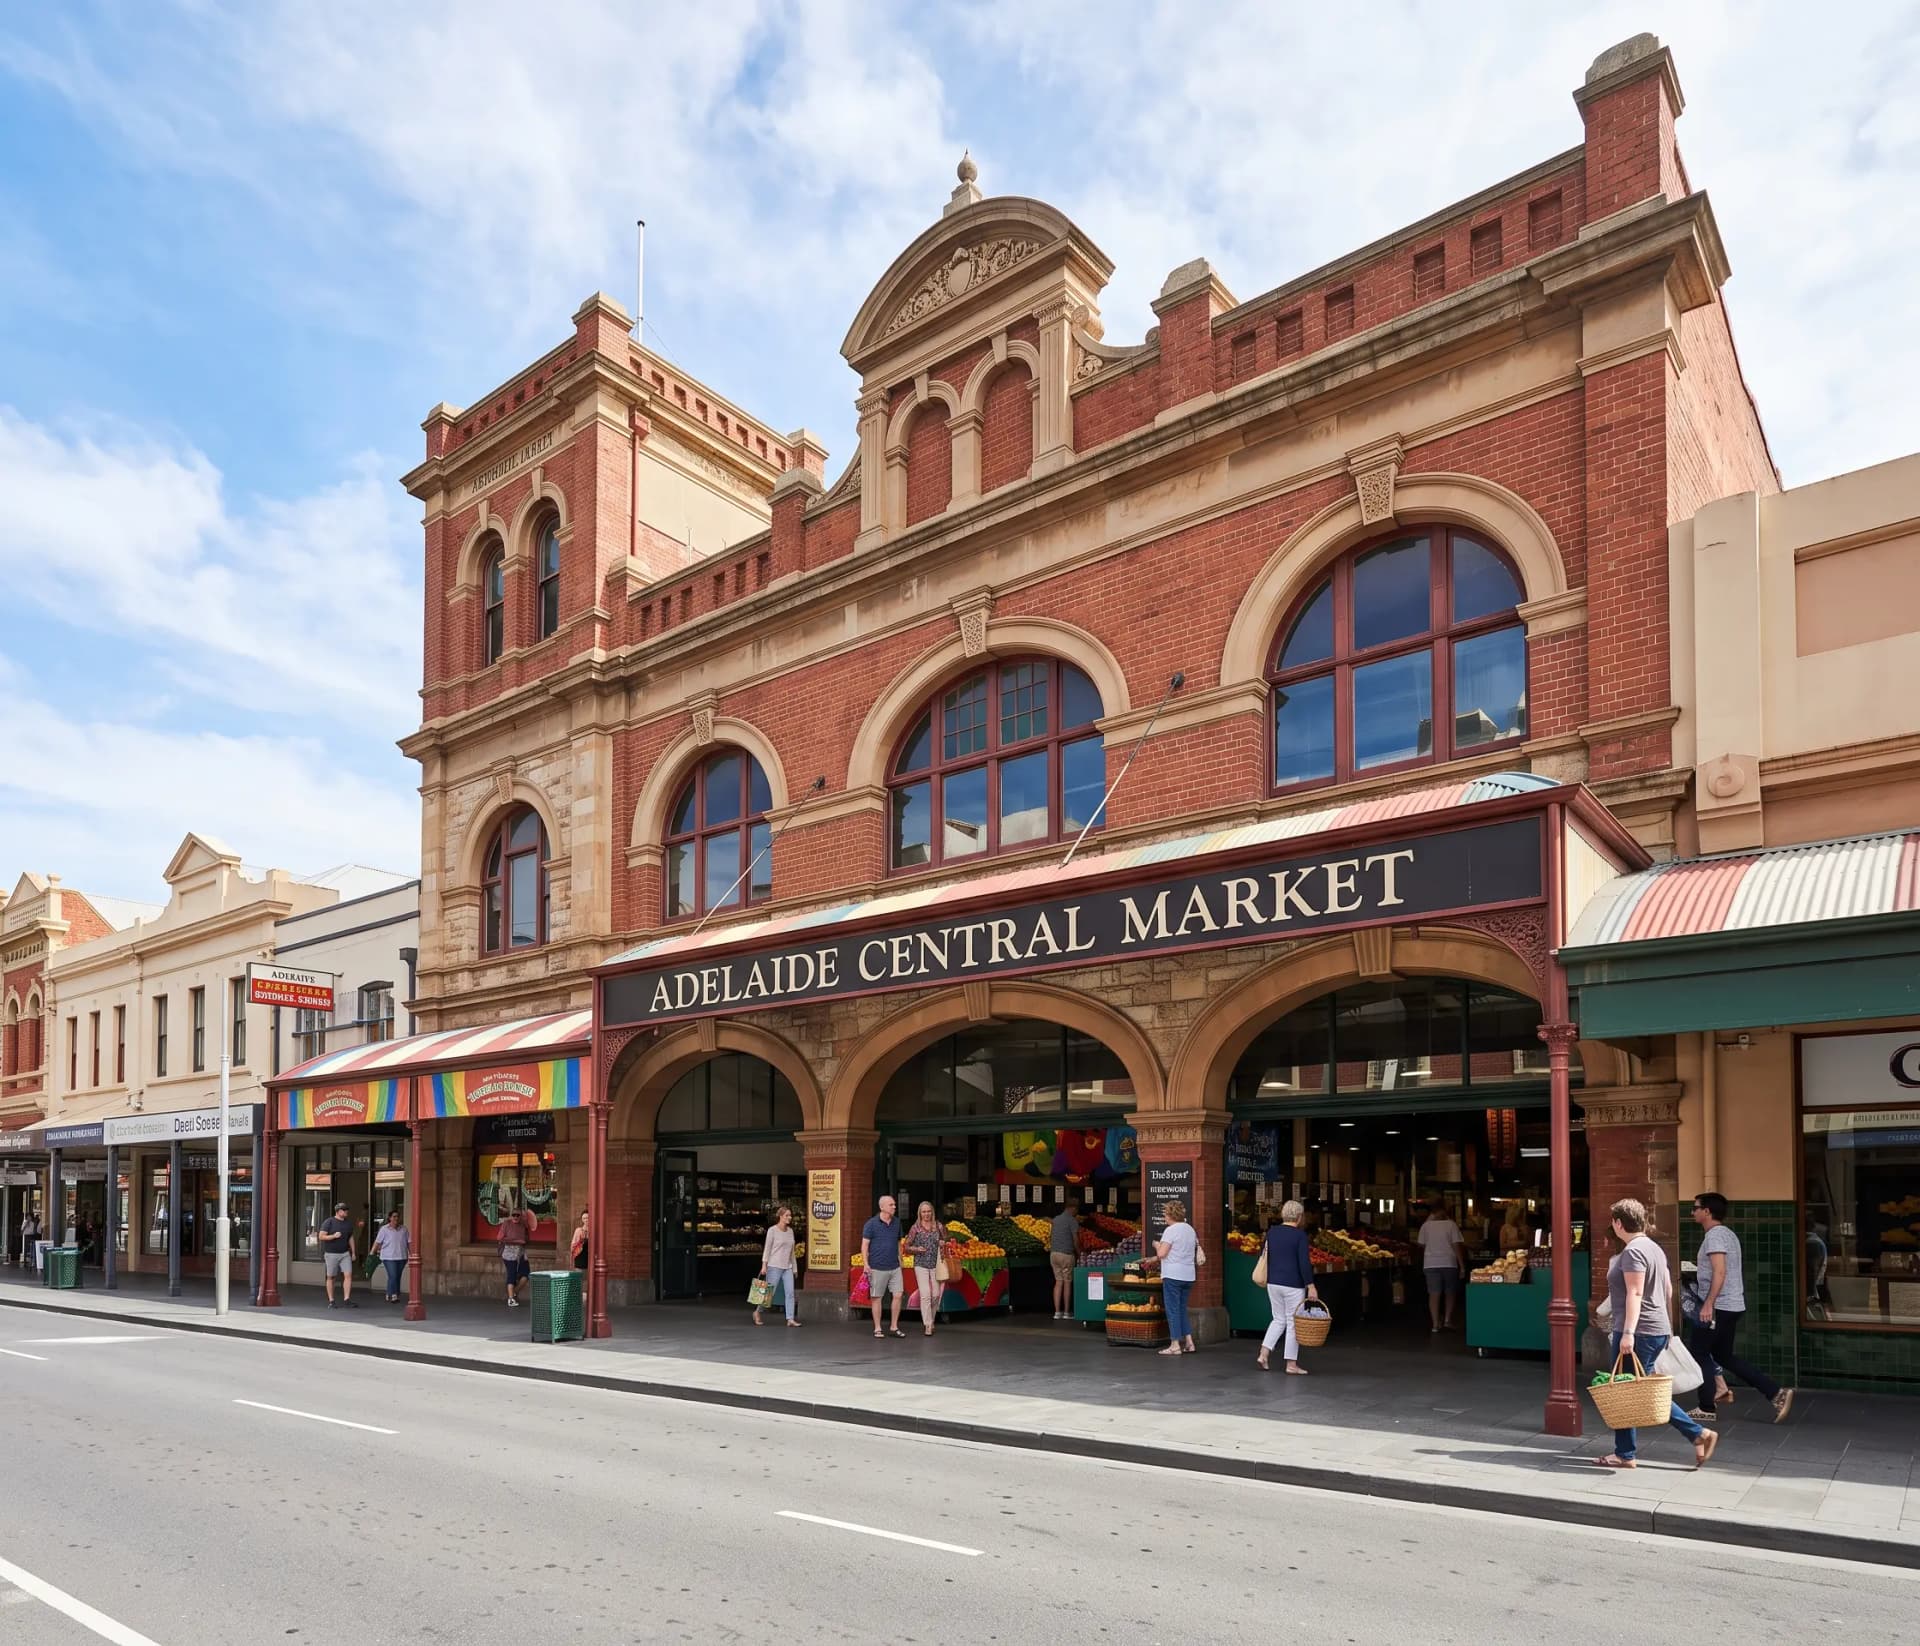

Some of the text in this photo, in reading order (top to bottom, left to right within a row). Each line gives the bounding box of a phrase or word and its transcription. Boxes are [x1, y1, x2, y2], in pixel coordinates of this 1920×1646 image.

[649, 849, 1414, 1013] ADELAIDE CENTRAL MARKET
